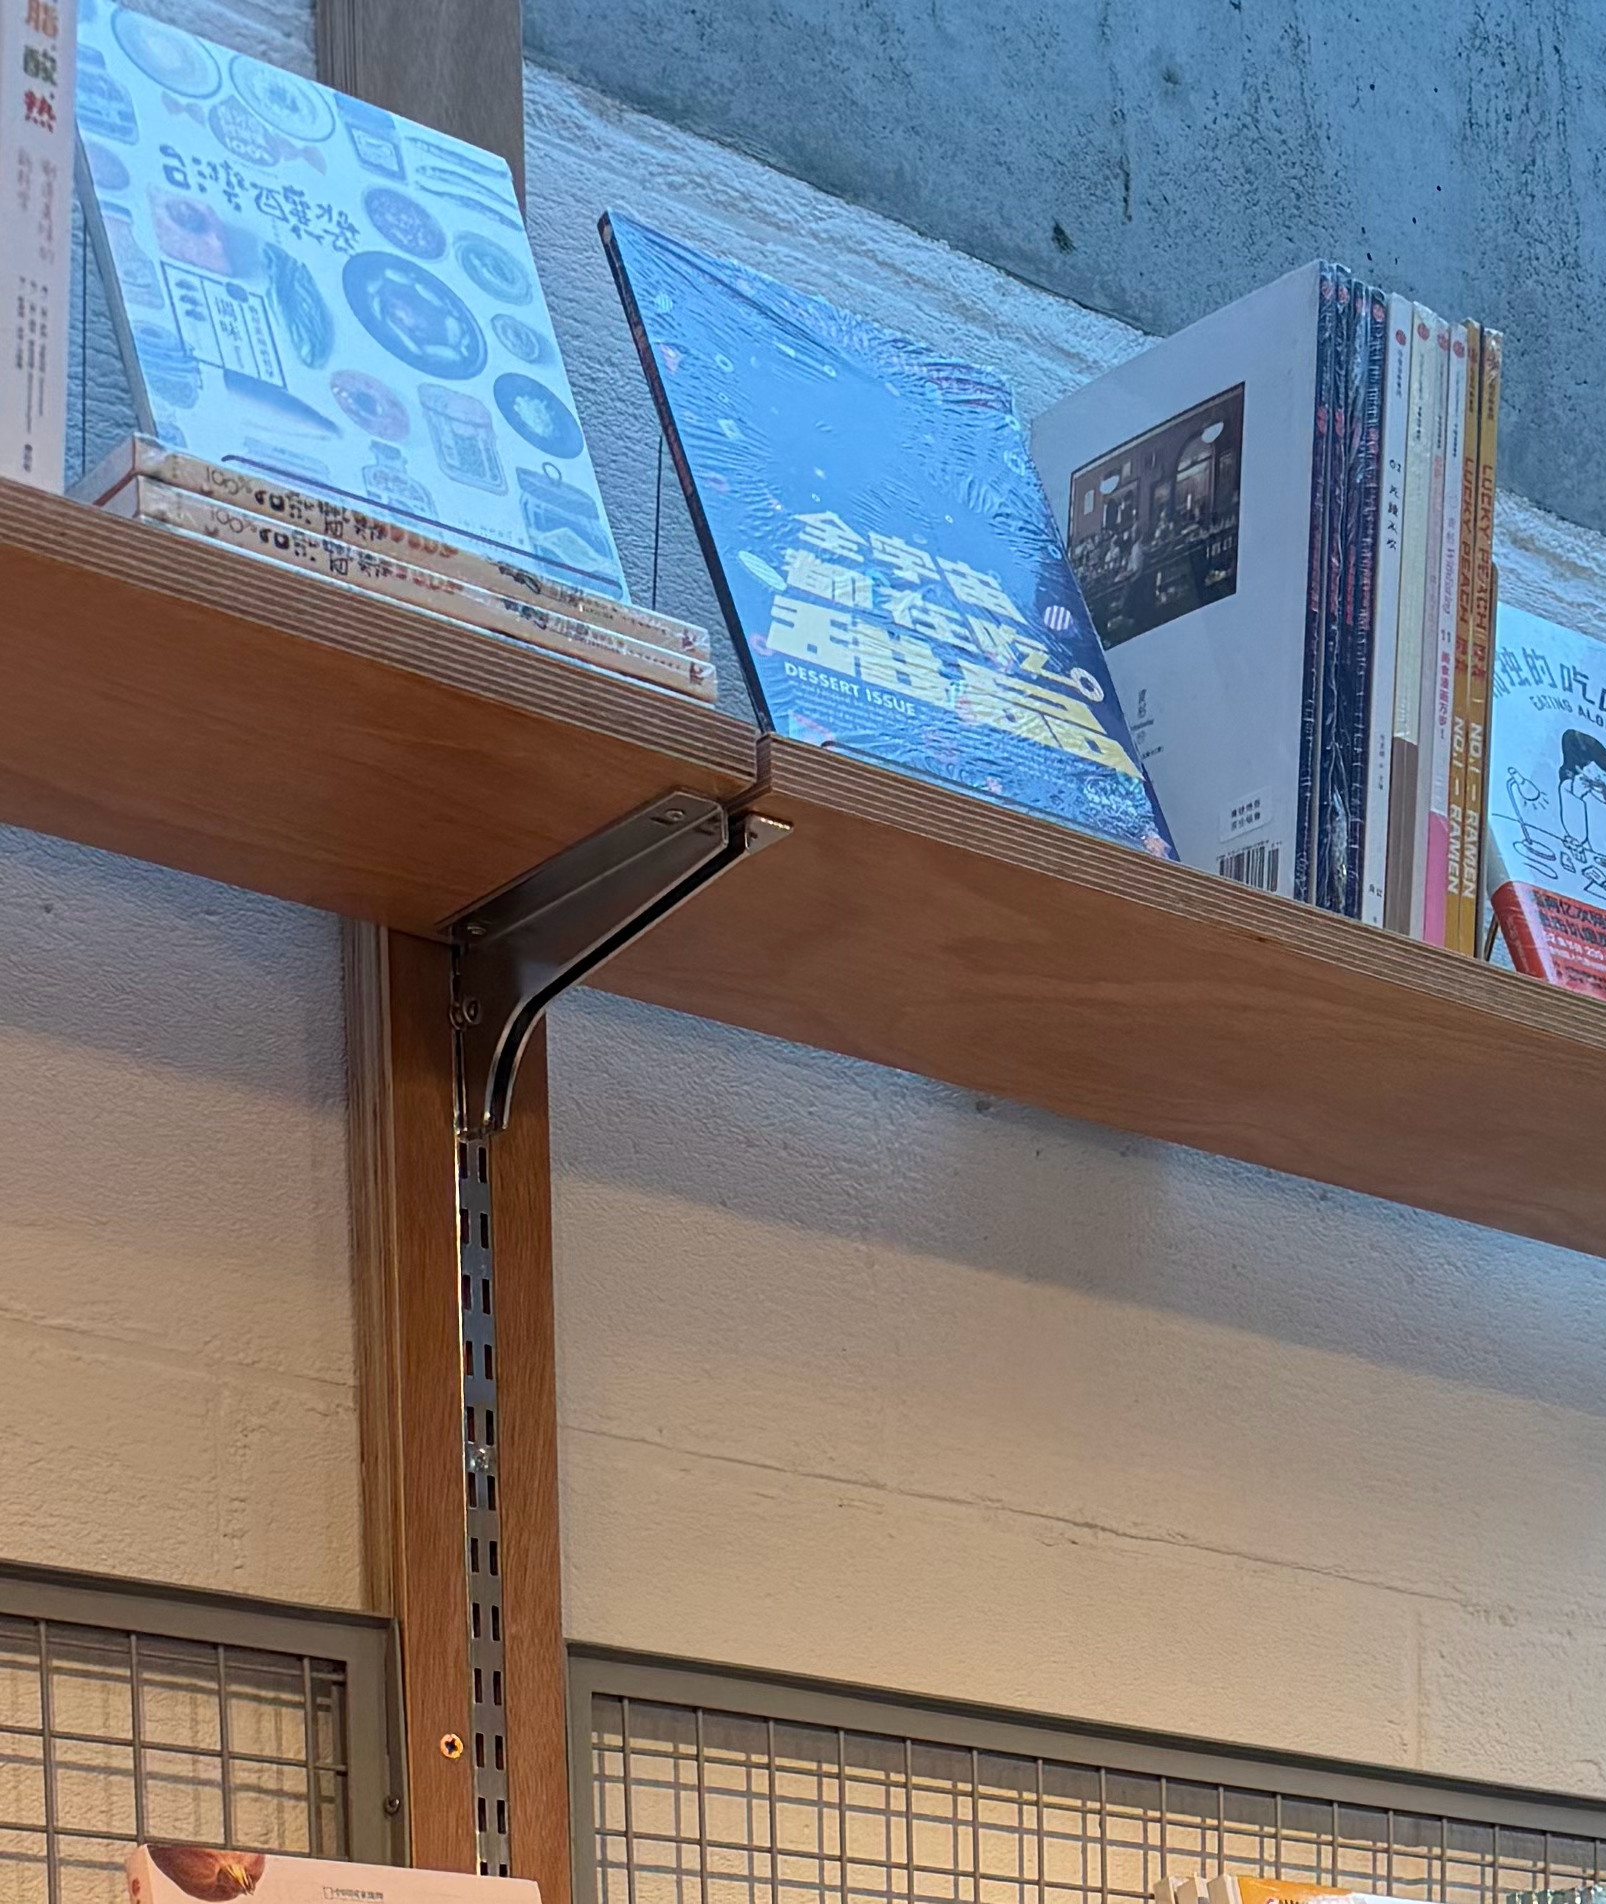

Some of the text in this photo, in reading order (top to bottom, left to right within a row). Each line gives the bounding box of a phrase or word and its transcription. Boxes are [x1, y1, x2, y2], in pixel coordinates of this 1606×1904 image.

[1459, 457, 1474, 533] LUCKY
[1478, 464, 1493, 541] LUCKY
[1456, 541, 1472, 625] PEACH
[1474, 548, 1492, 631] PEACH
[785, 661, 916, 717] DESSERT ISSUE
[1448, 803, 1463, 895] RAMEN
[1462, 809, 1479, 899] RAMEN
